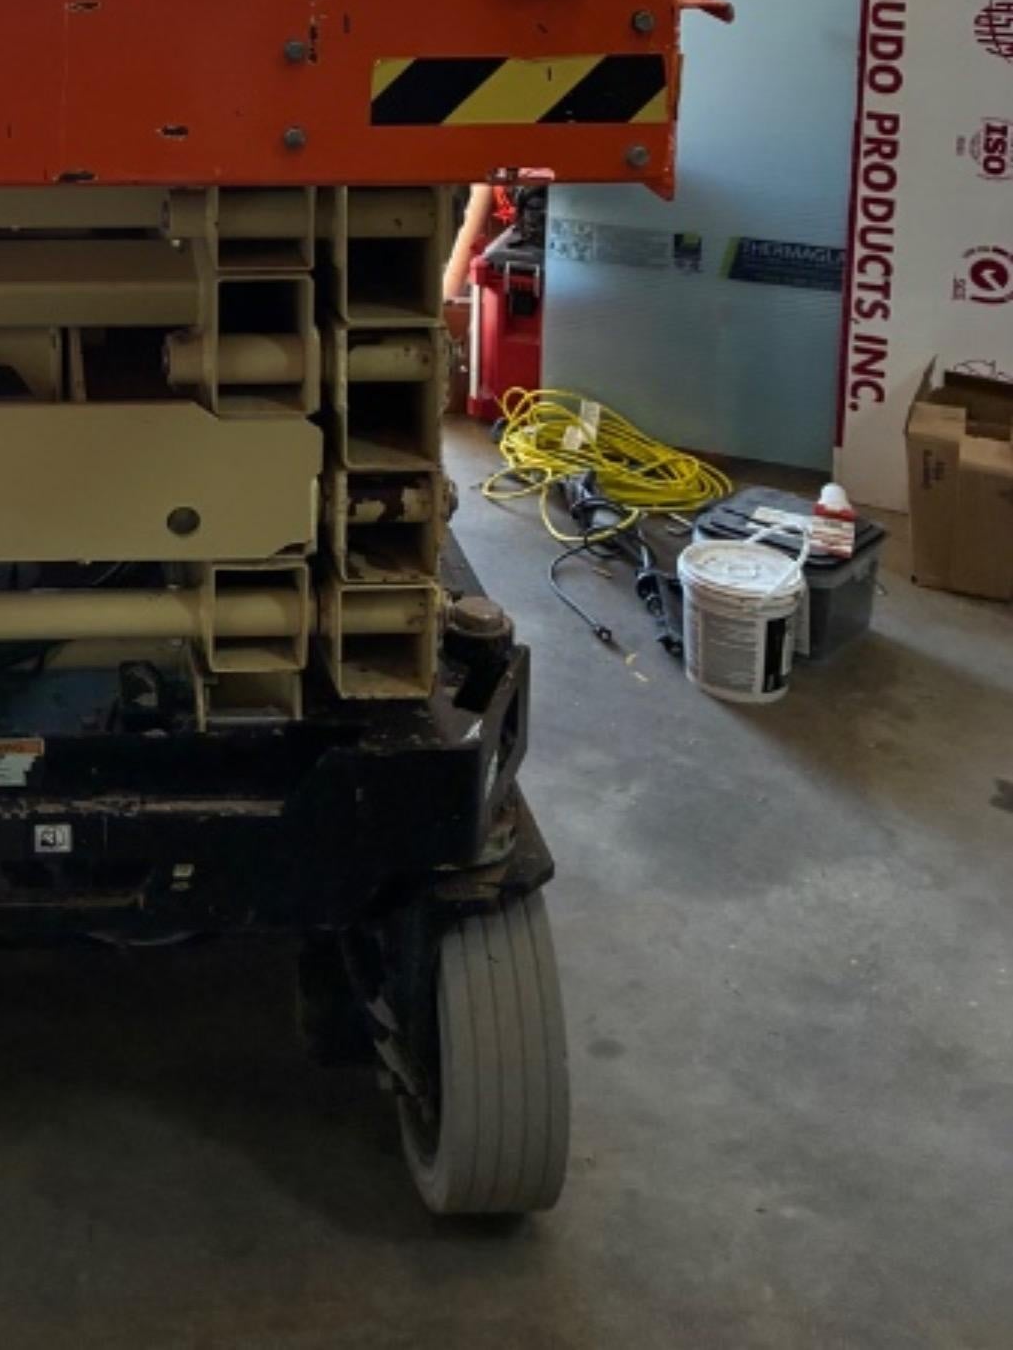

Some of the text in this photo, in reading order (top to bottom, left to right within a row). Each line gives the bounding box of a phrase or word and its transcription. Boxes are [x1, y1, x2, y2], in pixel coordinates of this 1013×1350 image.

[983, 122, 1008, 176] ISO
[852, 111, 901, 326] PRODUCTS,
[846, 333, 890, 414] INC.
